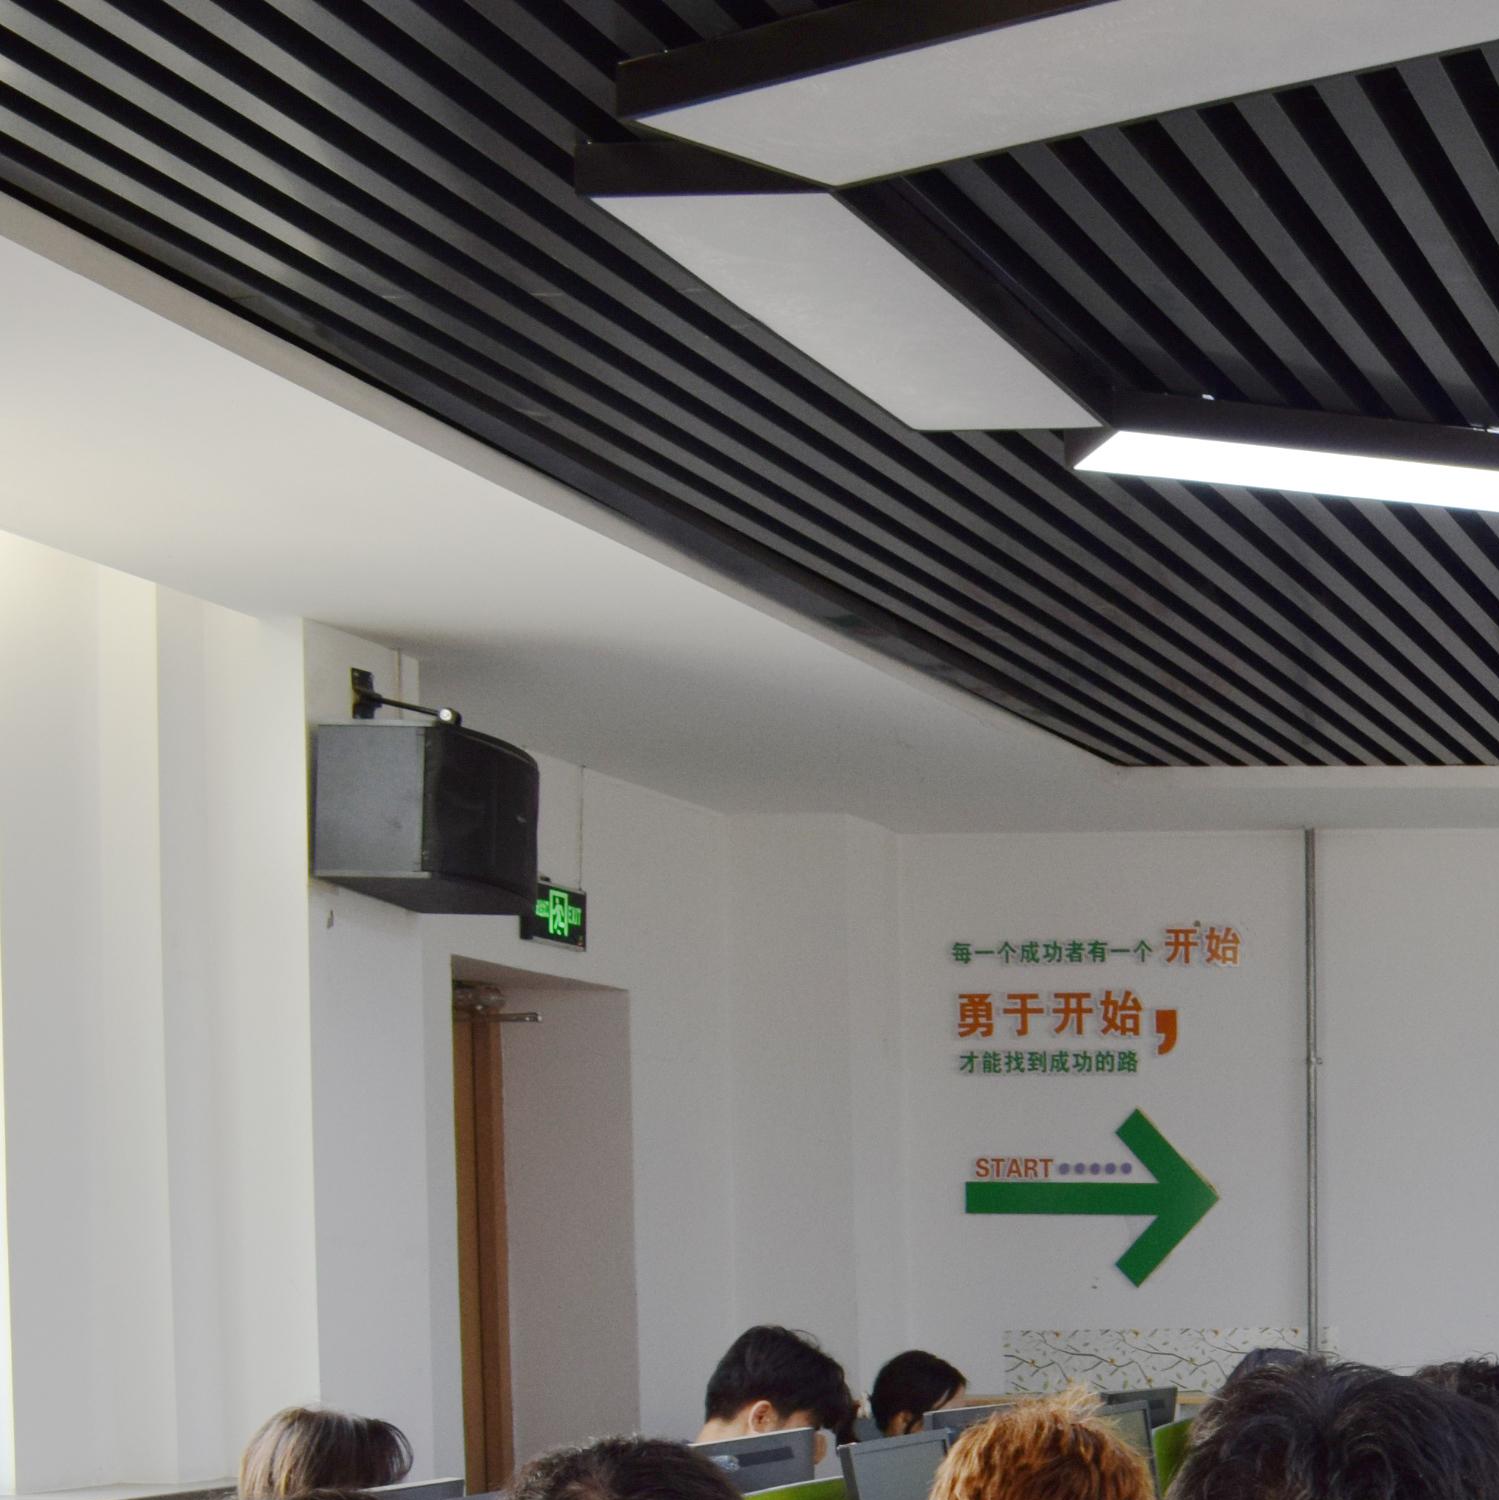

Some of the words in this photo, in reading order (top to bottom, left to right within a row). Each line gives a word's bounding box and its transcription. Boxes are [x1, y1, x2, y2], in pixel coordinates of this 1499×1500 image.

[952, 941, 1154, 965] 每一个成功者有一个
[1164, 927, 1241, 965] 开始
[959, 1051, 1139, 1074] 才能找到成功的路
[975, 1158, 1054, 1180] START
